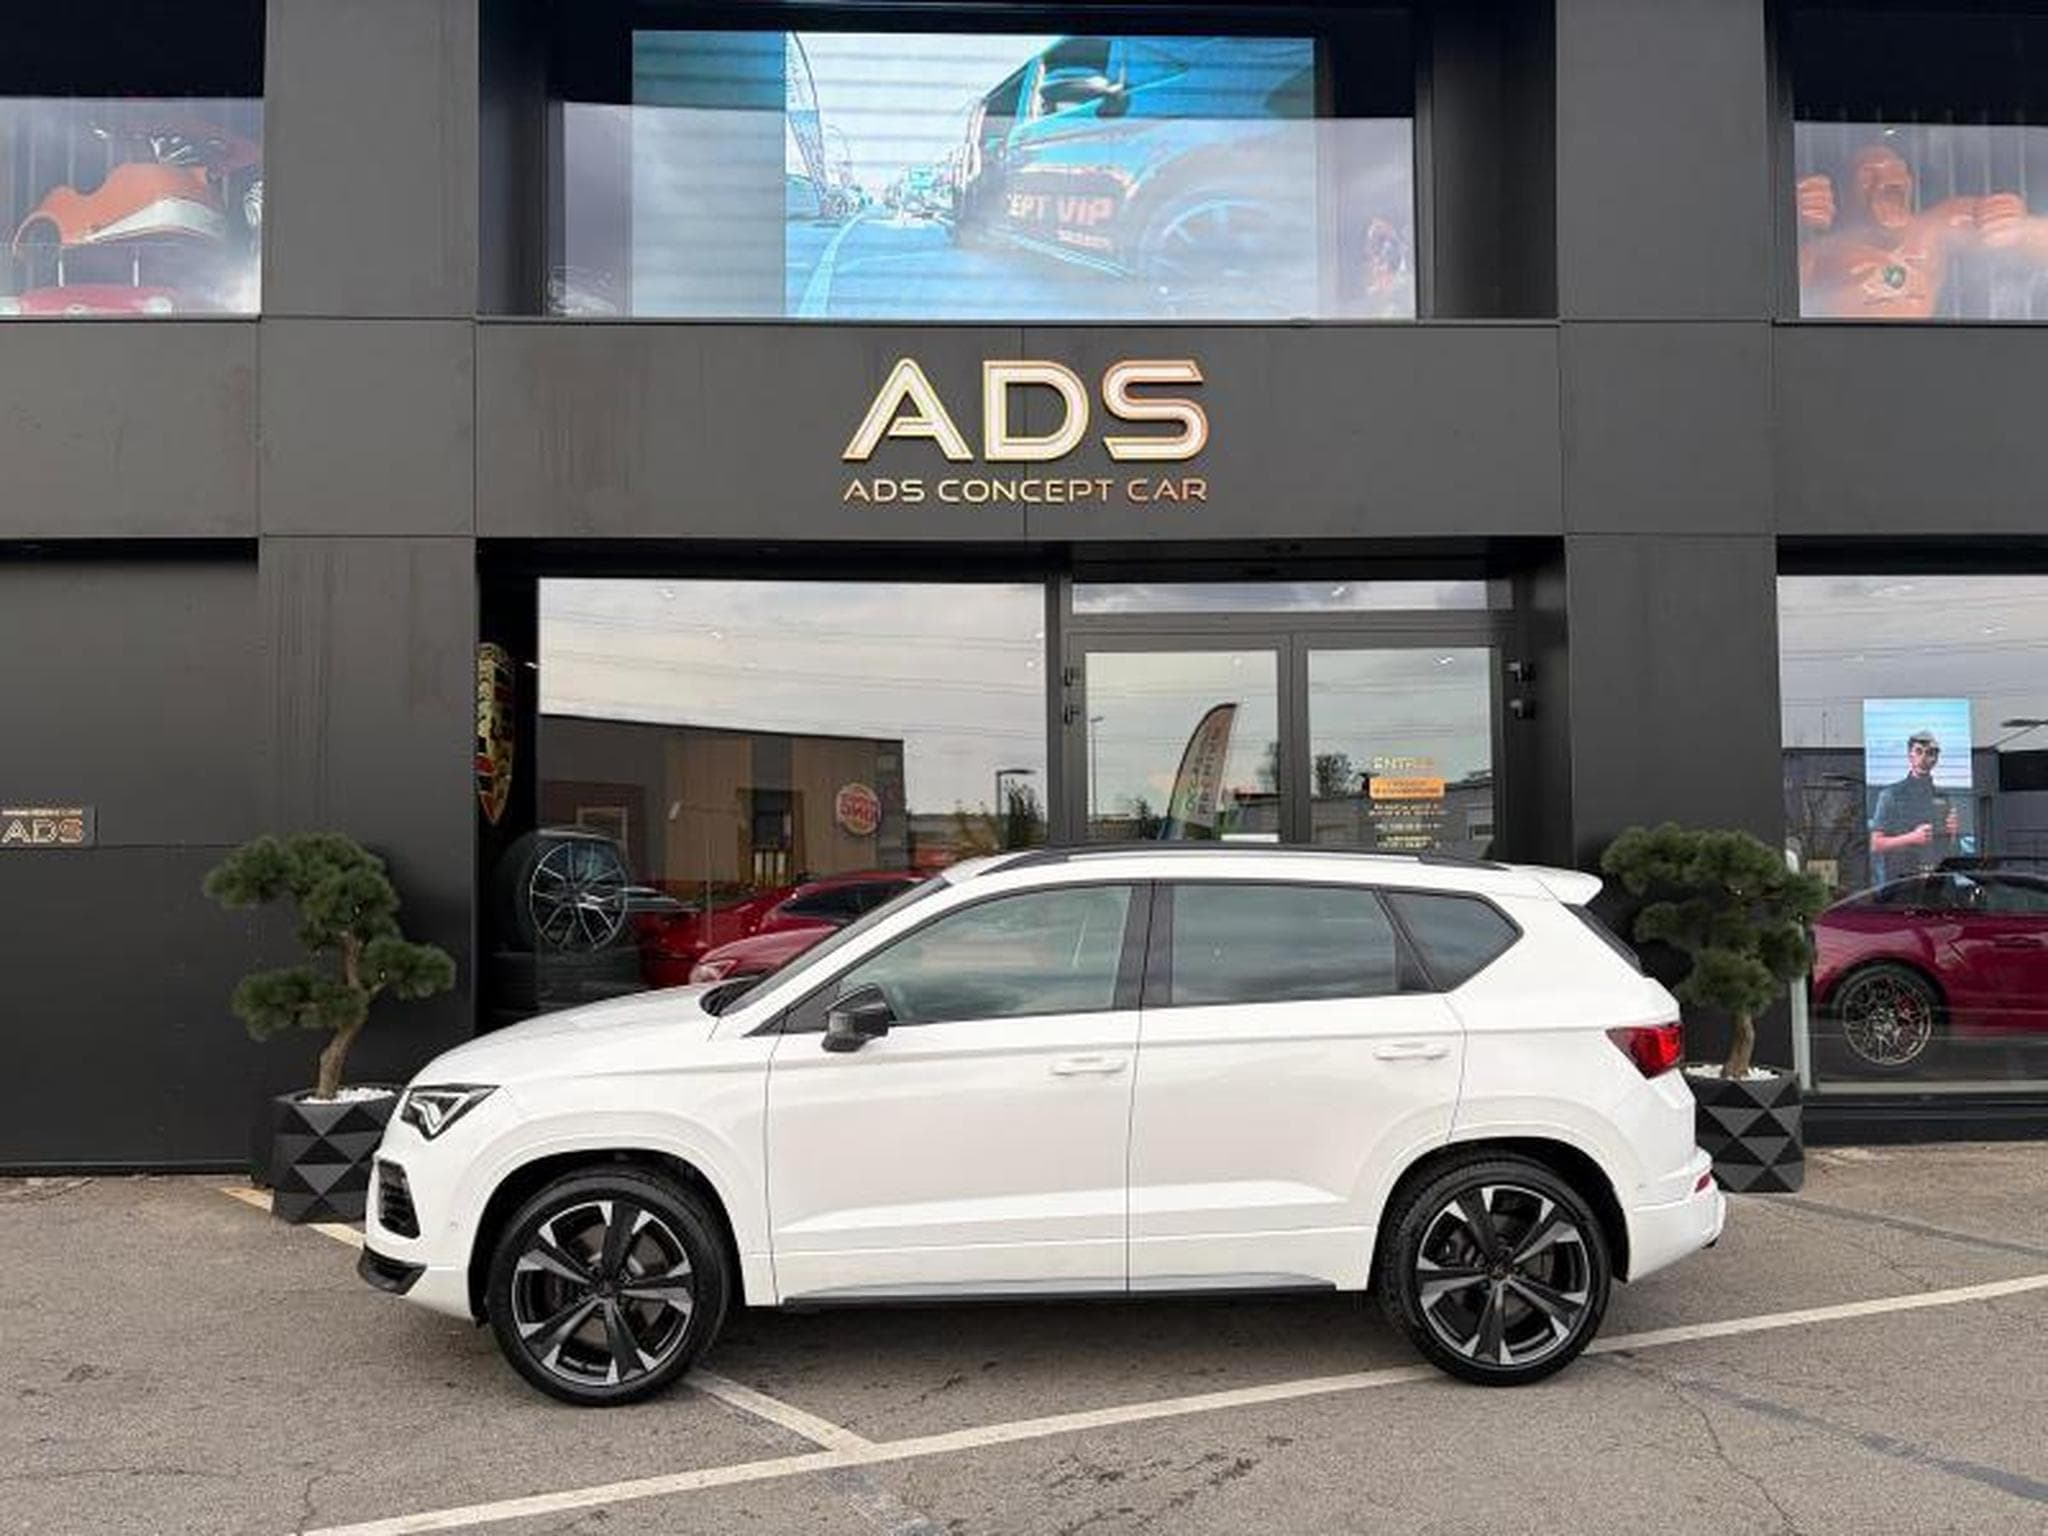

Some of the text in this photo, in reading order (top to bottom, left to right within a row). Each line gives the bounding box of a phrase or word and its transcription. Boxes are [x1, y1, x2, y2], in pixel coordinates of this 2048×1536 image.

[1056, 195, 1113, 225] VIP
[842, 358, 1209, 461] ADS
[844, 478, 1207, 502] ADS CONCEPT CAR
[1, 819, 83, 843] ADS
